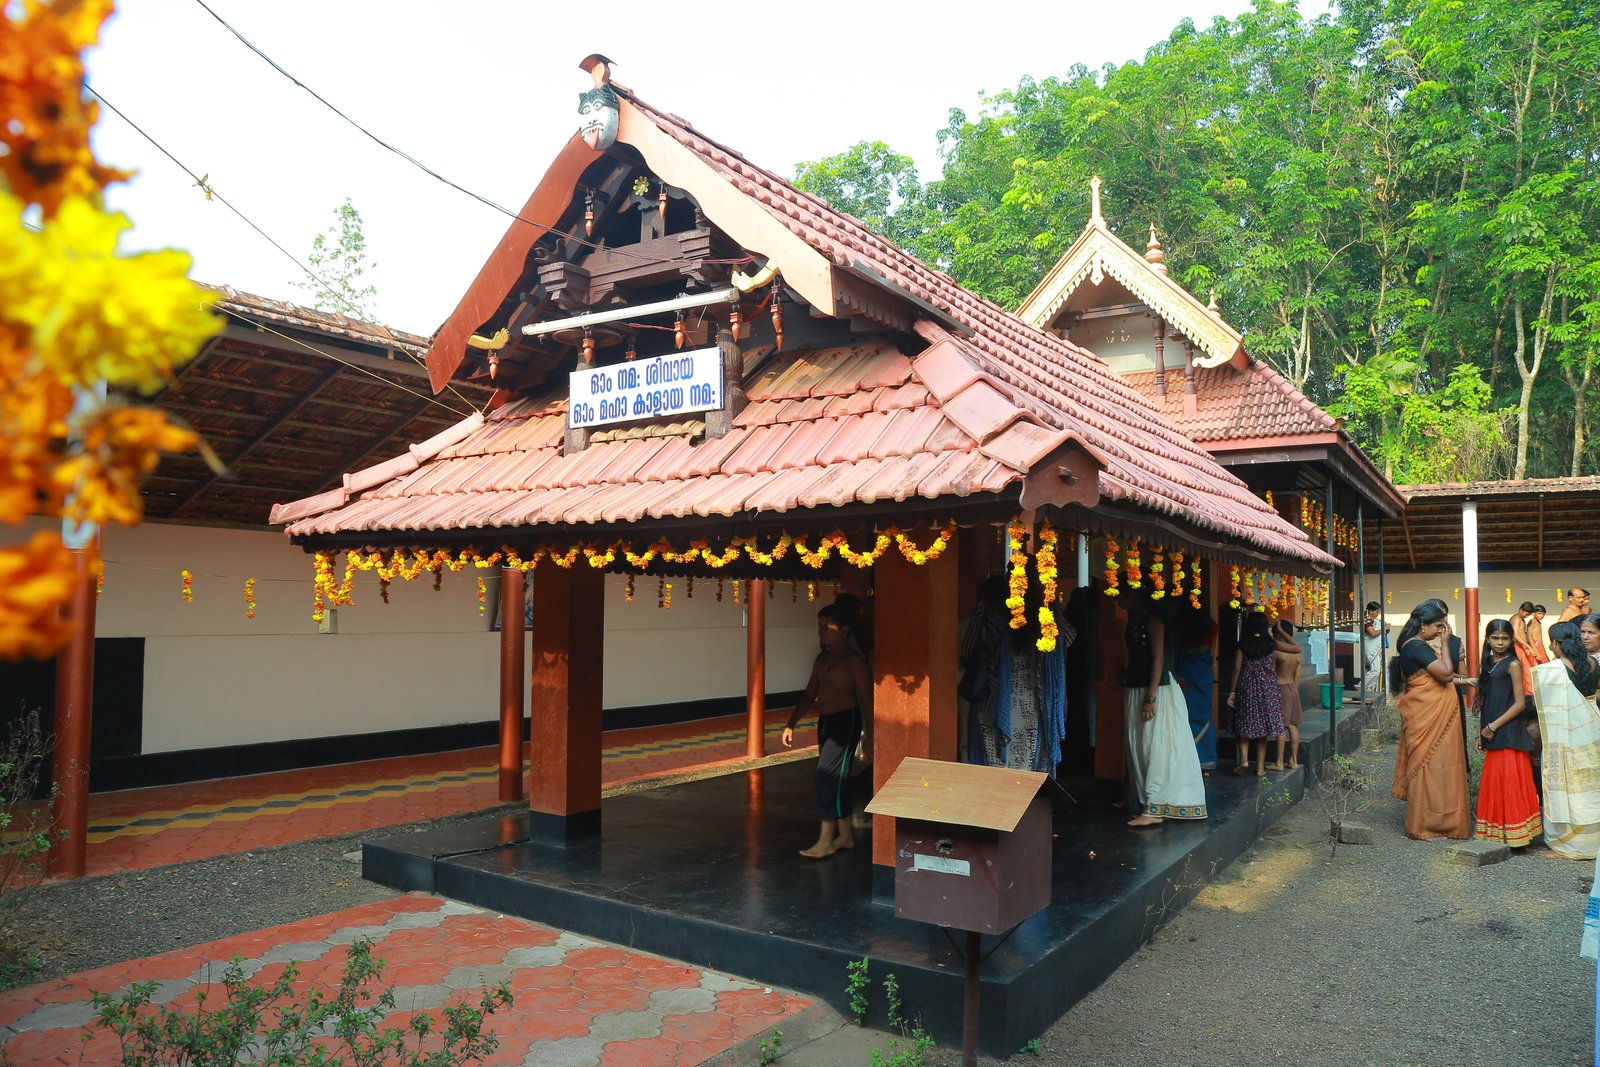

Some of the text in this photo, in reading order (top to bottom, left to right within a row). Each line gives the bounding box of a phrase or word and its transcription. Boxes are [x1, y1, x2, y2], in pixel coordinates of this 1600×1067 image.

[646, 357, 694, 386] ശിവായ
[600, 395, 627, 421] മഹാ
[633, 387, 684, 417] കാളായ
